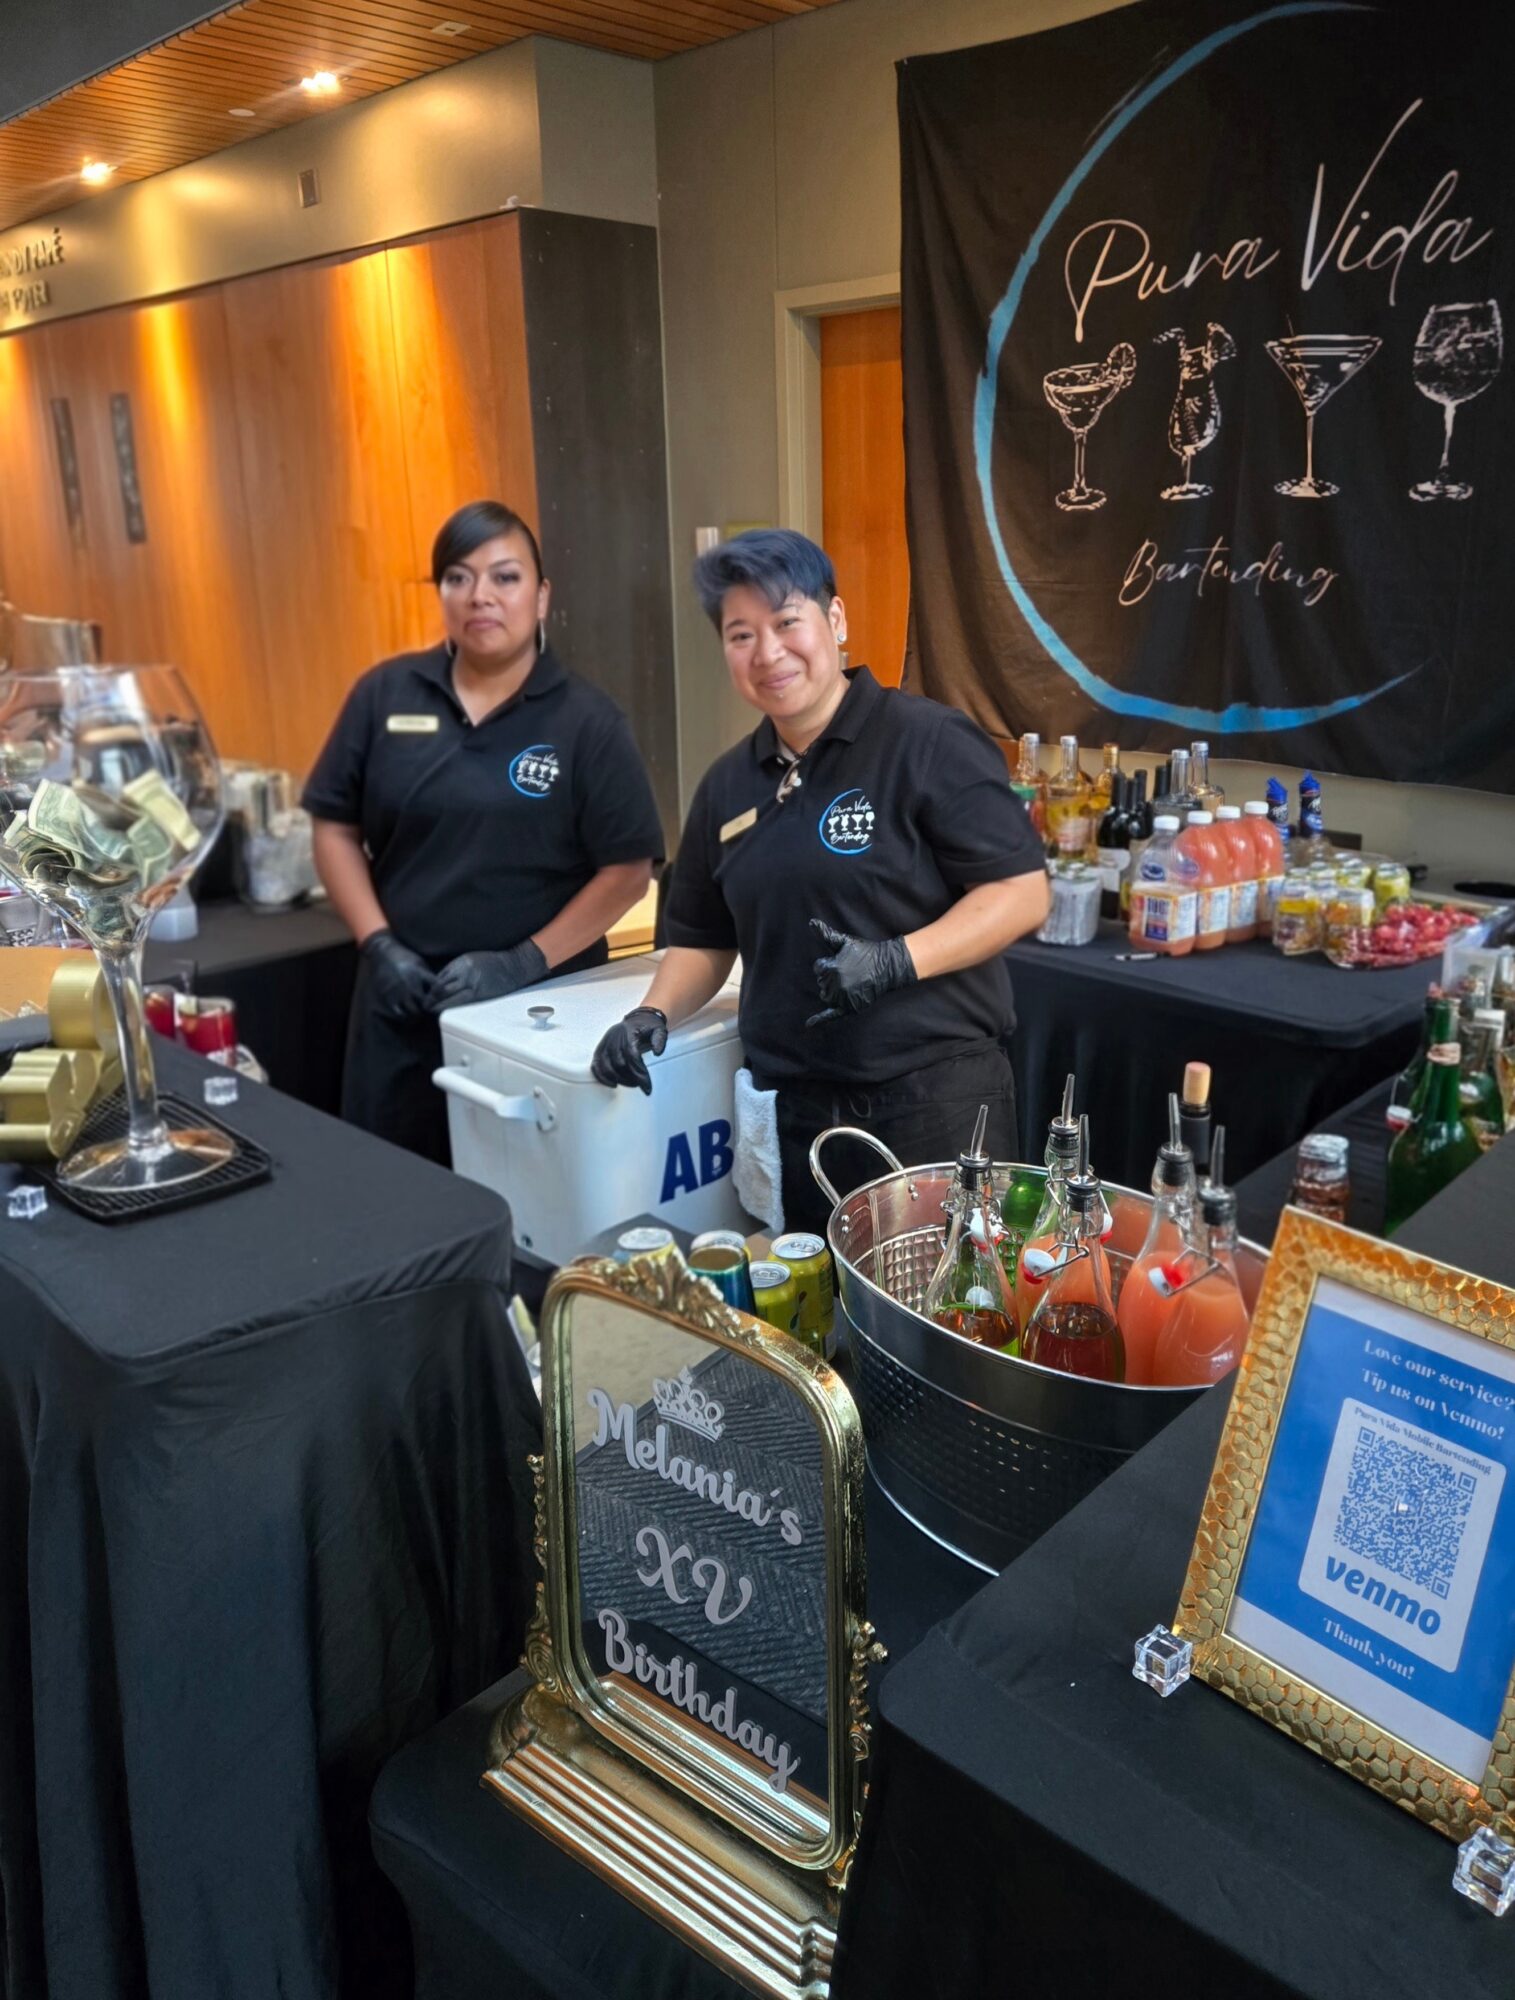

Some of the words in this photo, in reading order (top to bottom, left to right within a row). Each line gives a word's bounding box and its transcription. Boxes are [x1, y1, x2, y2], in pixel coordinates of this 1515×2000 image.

[1065, 219, 1280, 342] Pura
[1301, 98, 1493, 306] Vida
[1118, 537, 1338, 606] Bartending
[659, 1119, 734, 1204] AB
[1362, 1368, 1387, 1392] Tip
[1390, 1384, 1411, 1401] us
[1414, 1395, 1435, 1411] on
[1441, 1401, 1505, 1440] Venmo!
[1364, 1340, 1402, 1365] Love
[1405, 1358, 1436, 1378] our
[1439, 1372, 1515, 1411] service?
[587, 1388, 802, 1546] Melania's
[1354, 1407, 1377, 1424] Pura
[1379, 1418, 1401, 1433] Vida
[1403, 1426, 1435, 1448] Mobile
[1436, 1443, 1492, 1475] Bartending
[635, 1526, 753, 1625] XV
[1326, 1555, 1440, 1635] venmo
[1323, 1617, 1374, 1659] Thank
[1375, 1652, 1415, 1680] you!
[598, 1608, 799, 1793] Birthday
